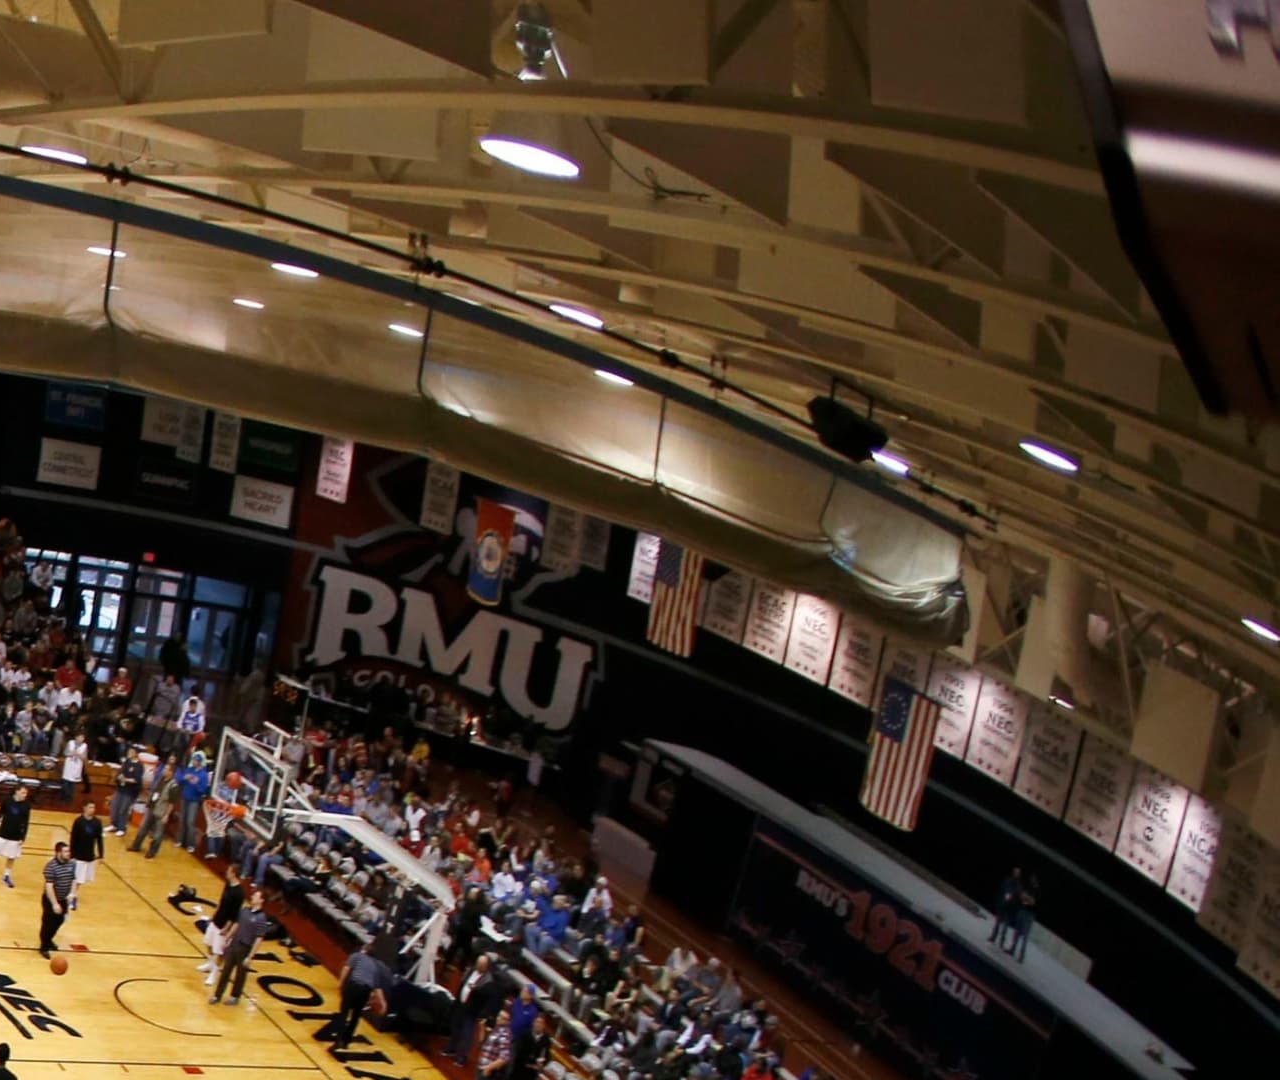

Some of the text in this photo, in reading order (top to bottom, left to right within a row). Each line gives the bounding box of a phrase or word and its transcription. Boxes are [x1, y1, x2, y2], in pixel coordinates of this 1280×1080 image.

[803, 616, 829, 637] NEC
[306, 564, 593, 731] RMU
[938, 685, 965, 708] NEC
[987, 710, 1015, 734] NEC
[1140, 795, 1170, 823] NEC
[844, 890, 944, 992] 1921
[938, 968, 990, 1016] CLUB
